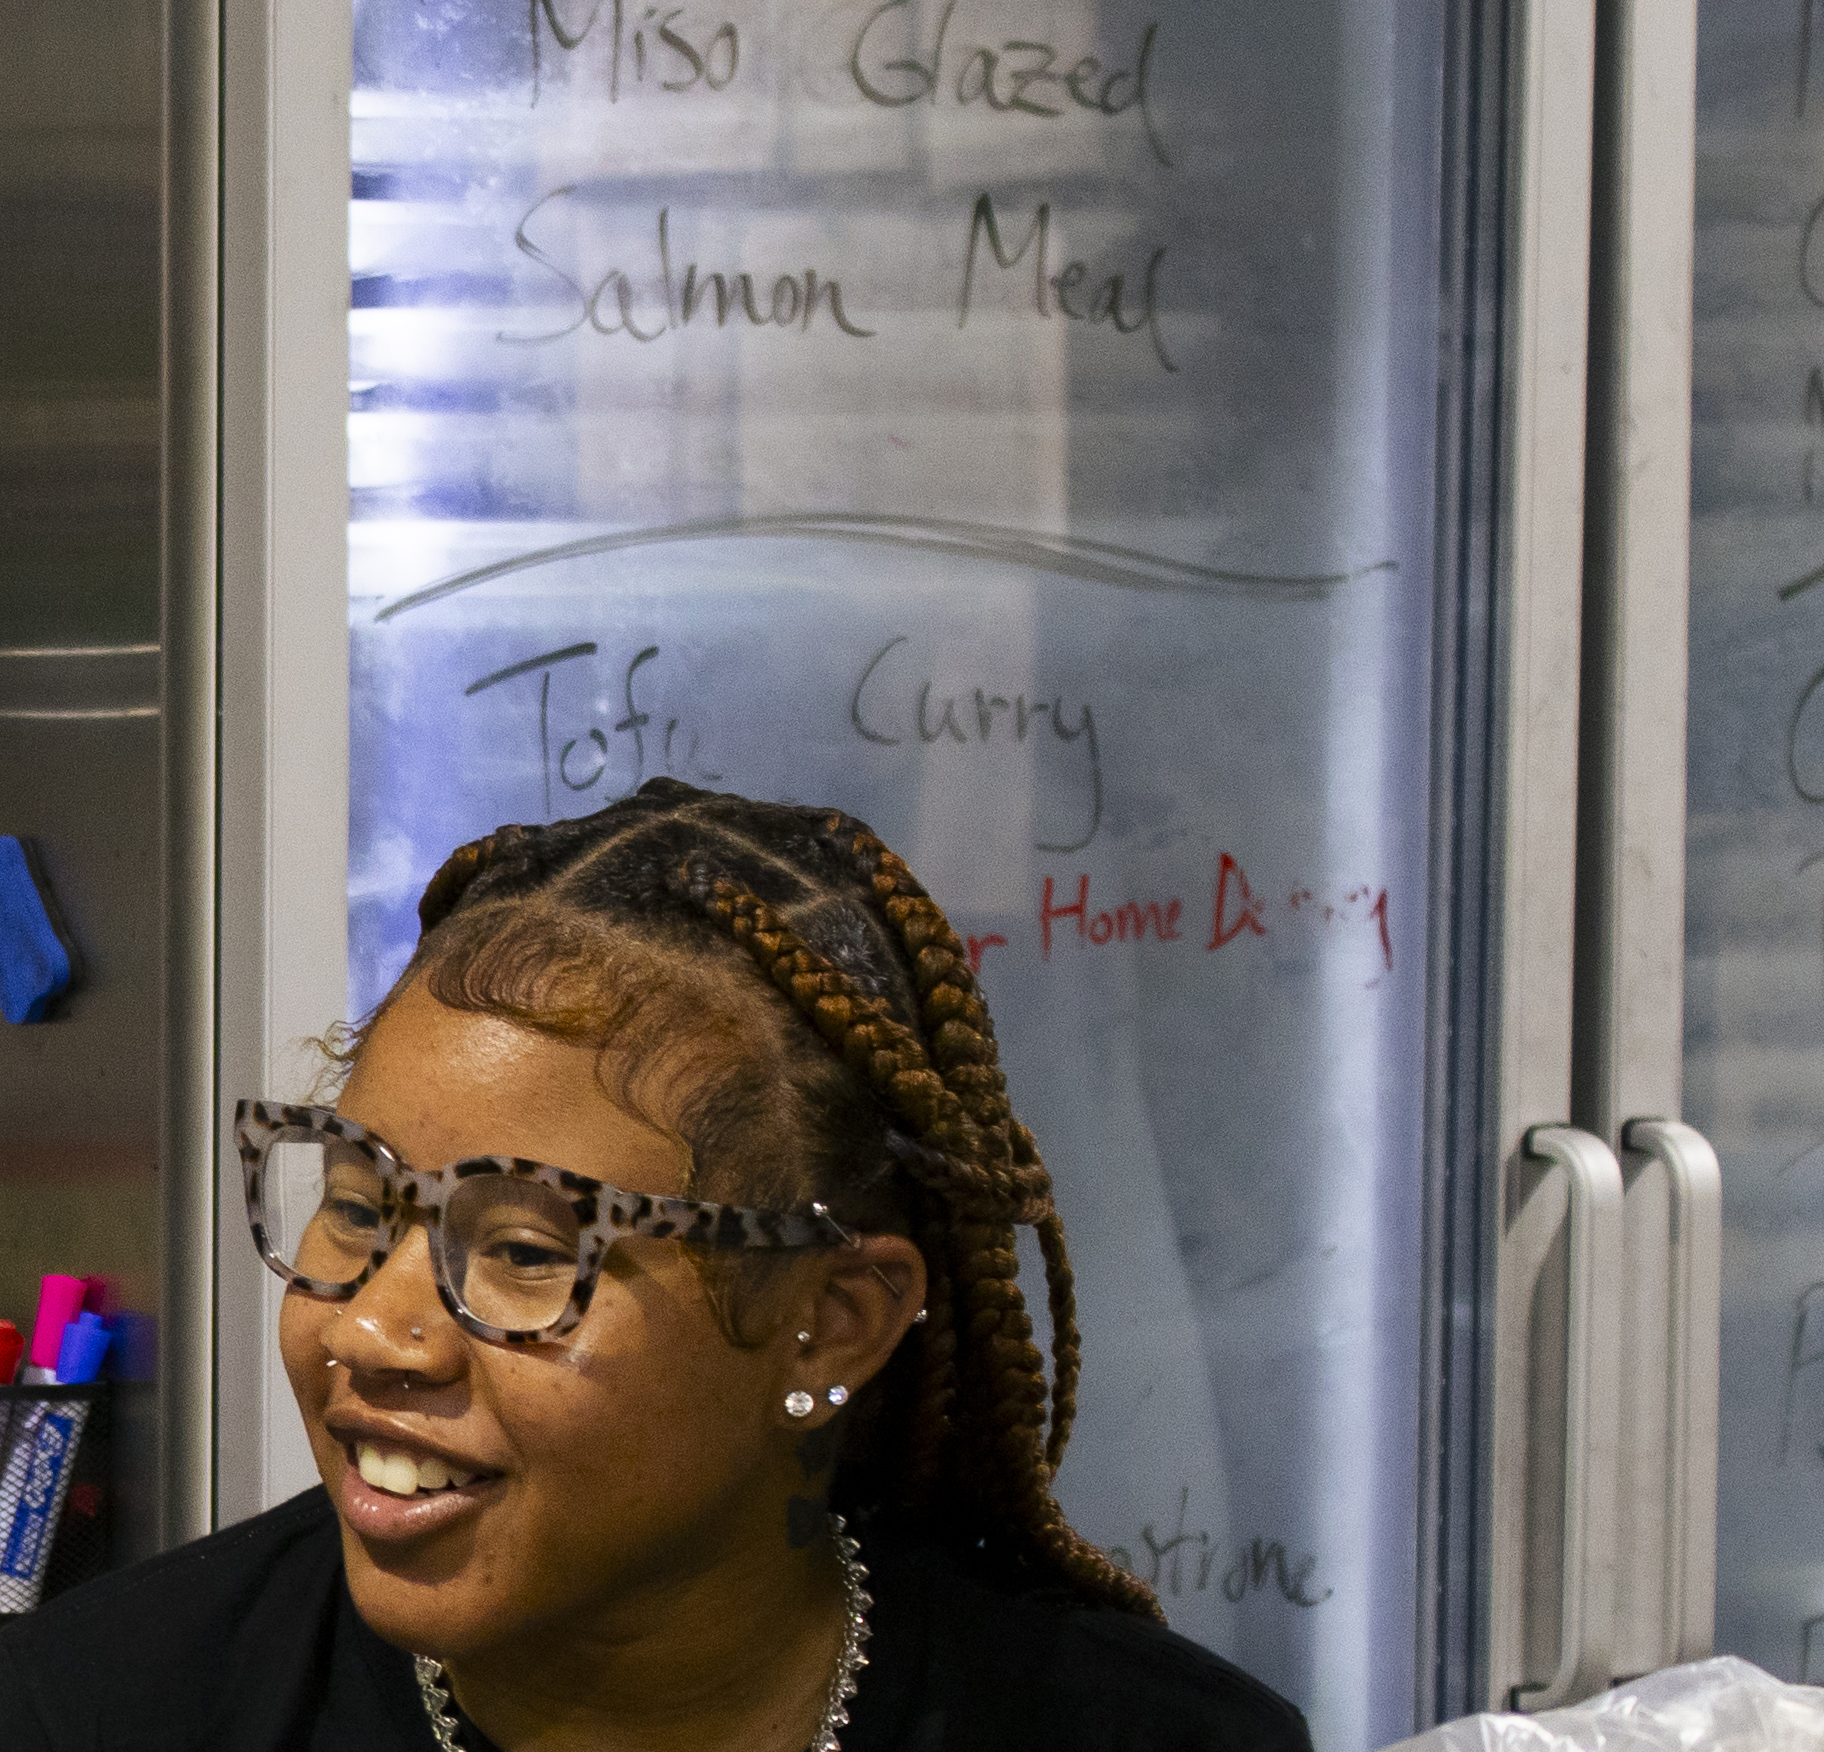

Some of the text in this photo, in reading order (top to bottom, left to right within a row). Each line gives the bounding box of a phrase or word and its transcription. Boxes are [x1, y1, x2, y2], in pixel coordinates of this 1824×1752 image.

[527, 0, 1173, 167] Miso Glazed
[495, 184, 1179, 373] Salmon Meal
[848, 636, 1106, 853] Curry
[1040, 875, 1182, 964] Home
